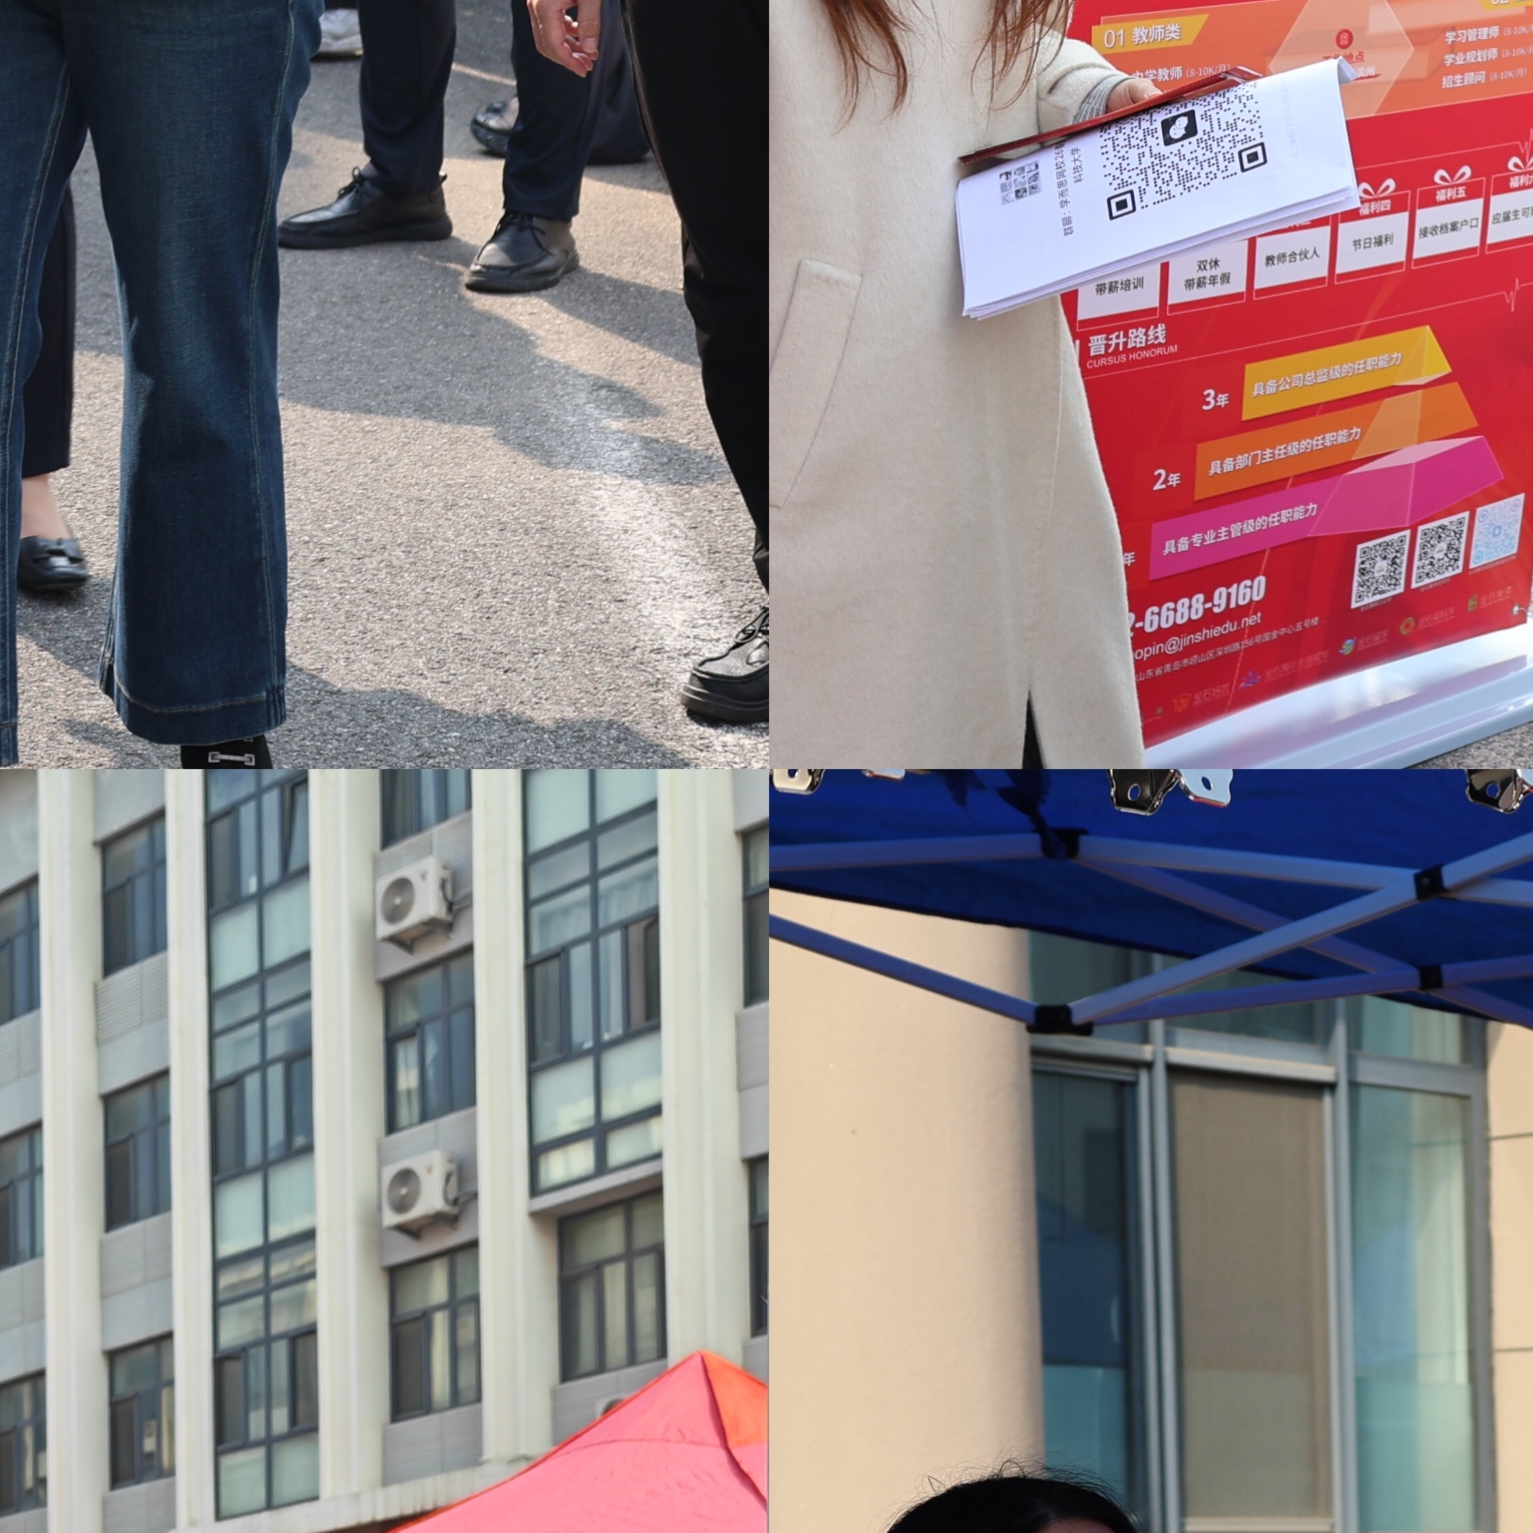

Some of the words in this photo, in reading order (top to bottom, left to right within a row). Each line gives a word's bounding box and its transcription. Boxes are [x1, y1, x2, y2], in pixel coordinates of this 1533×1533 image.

[1103, 28, 1126, 49] 01
[1131, 22, 1182, 46] 教师类
[1444, 25, 1500, 45] 学习管理师
[1443, 47, 1499, 67] 学业规划师
[1441, 70, 1486, 90] 招生顾问
[1435, 185, 1467, 202] 福利五
[1358, 198, 1392, 216] 福利四
[1418, 217, 1480, 240] 接收档案户口
[1351, 232, 1395, 252] 节日福利
[1195, 257, 1221, 273] 双休
[1264, 247, 1321, 268] 教师合伙人
[1094, 275, 1145, 296] 带薪培训
[1183, 271, 1232, 292] 带薪年假
[1087, 322, 1168, 357] 晋升路线
[1086, 353, 1127, 369] CURSUS
[1128, 344, 1179, 363] HONORUM
[1201, 387, 1230, 411] 3年
[1251, 350, 1403, 398] 具备公司总监级的任职能力
[1152, 468, 1182, 492] 2年
[1208, 425, 1362, 477] 具备部门主任级的任职能力
[1162, 501, 1319, 557] 具备专业主管级的任职能力
[1133, 611, 1263, 662] opin@jinshiedu.net
